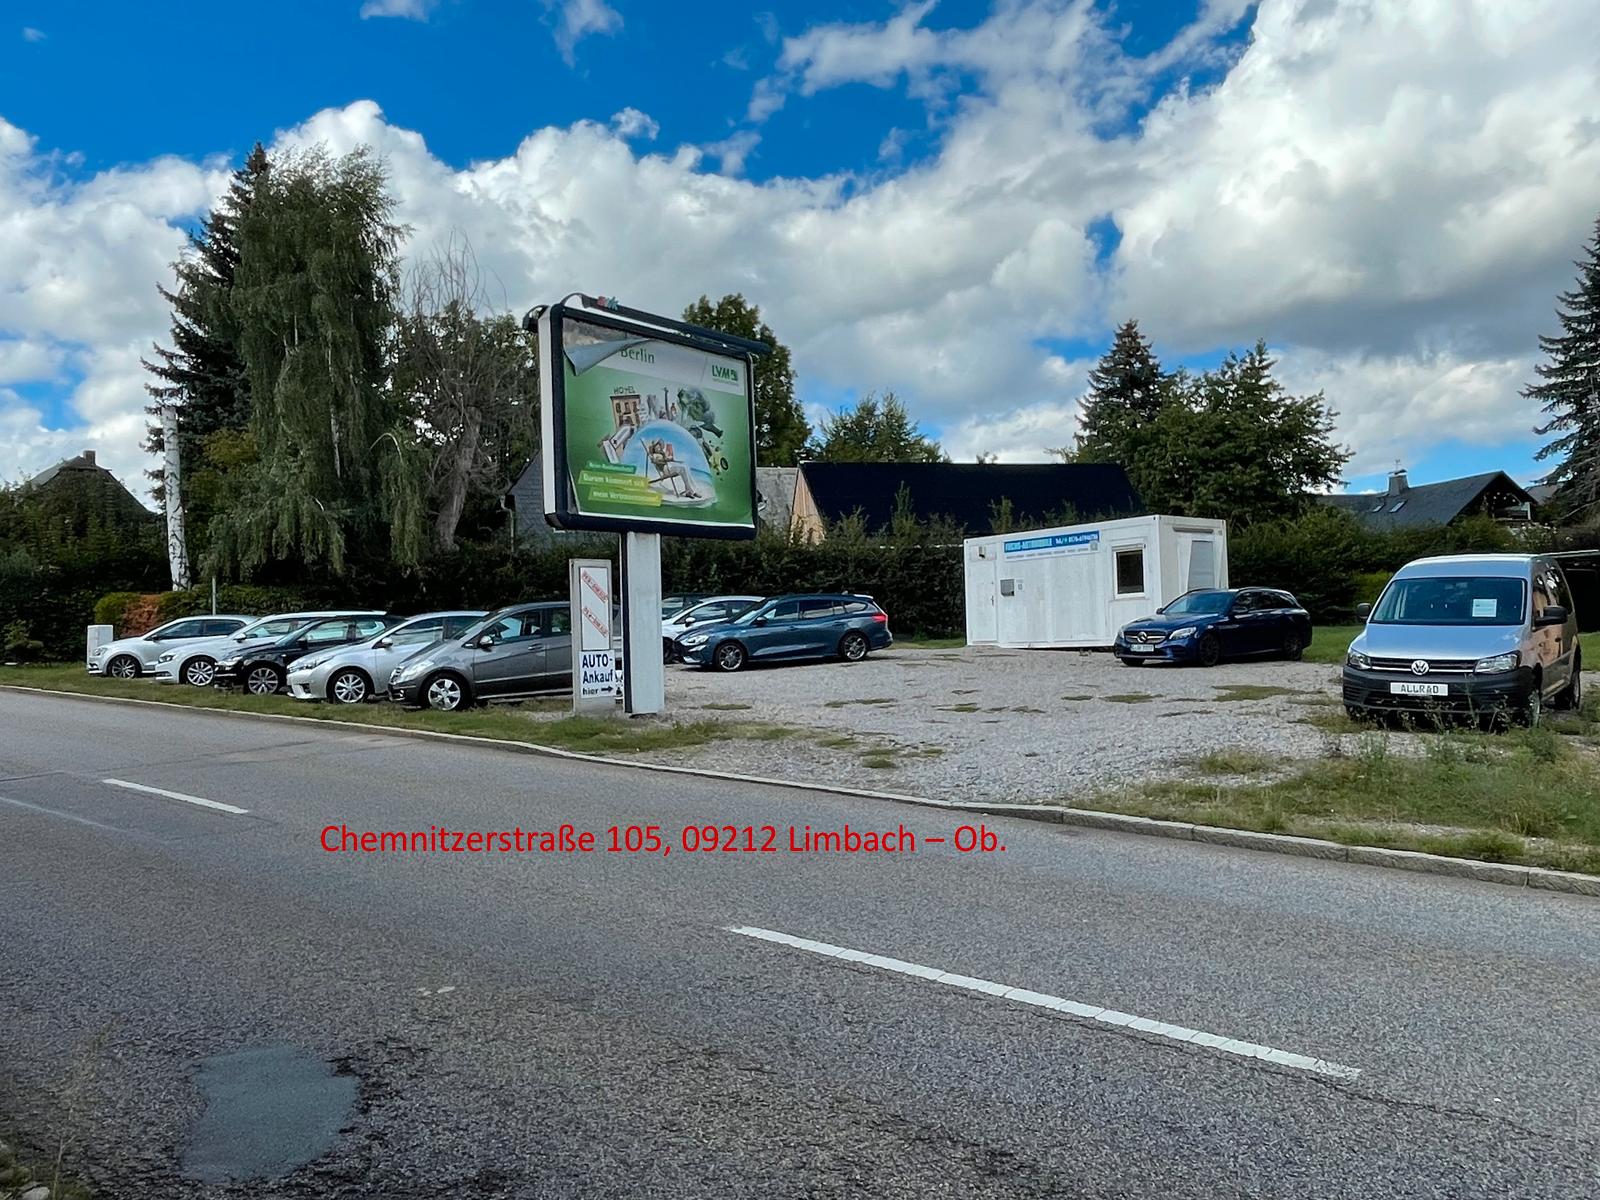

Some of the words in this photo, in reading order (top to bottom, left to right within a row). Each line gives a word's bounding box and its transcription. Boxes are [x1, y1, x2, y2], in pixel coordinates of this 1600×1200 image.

[620, 348, 655, 364] Berlin
[712, 365, 730, 378] LVM
[582, 654, 613, 668] AUTO-
[582, 669, 613, 684] Ankauf
[582, 687, 598, 695] hier
[1400, 684, 1439, 694] ALLRAD
